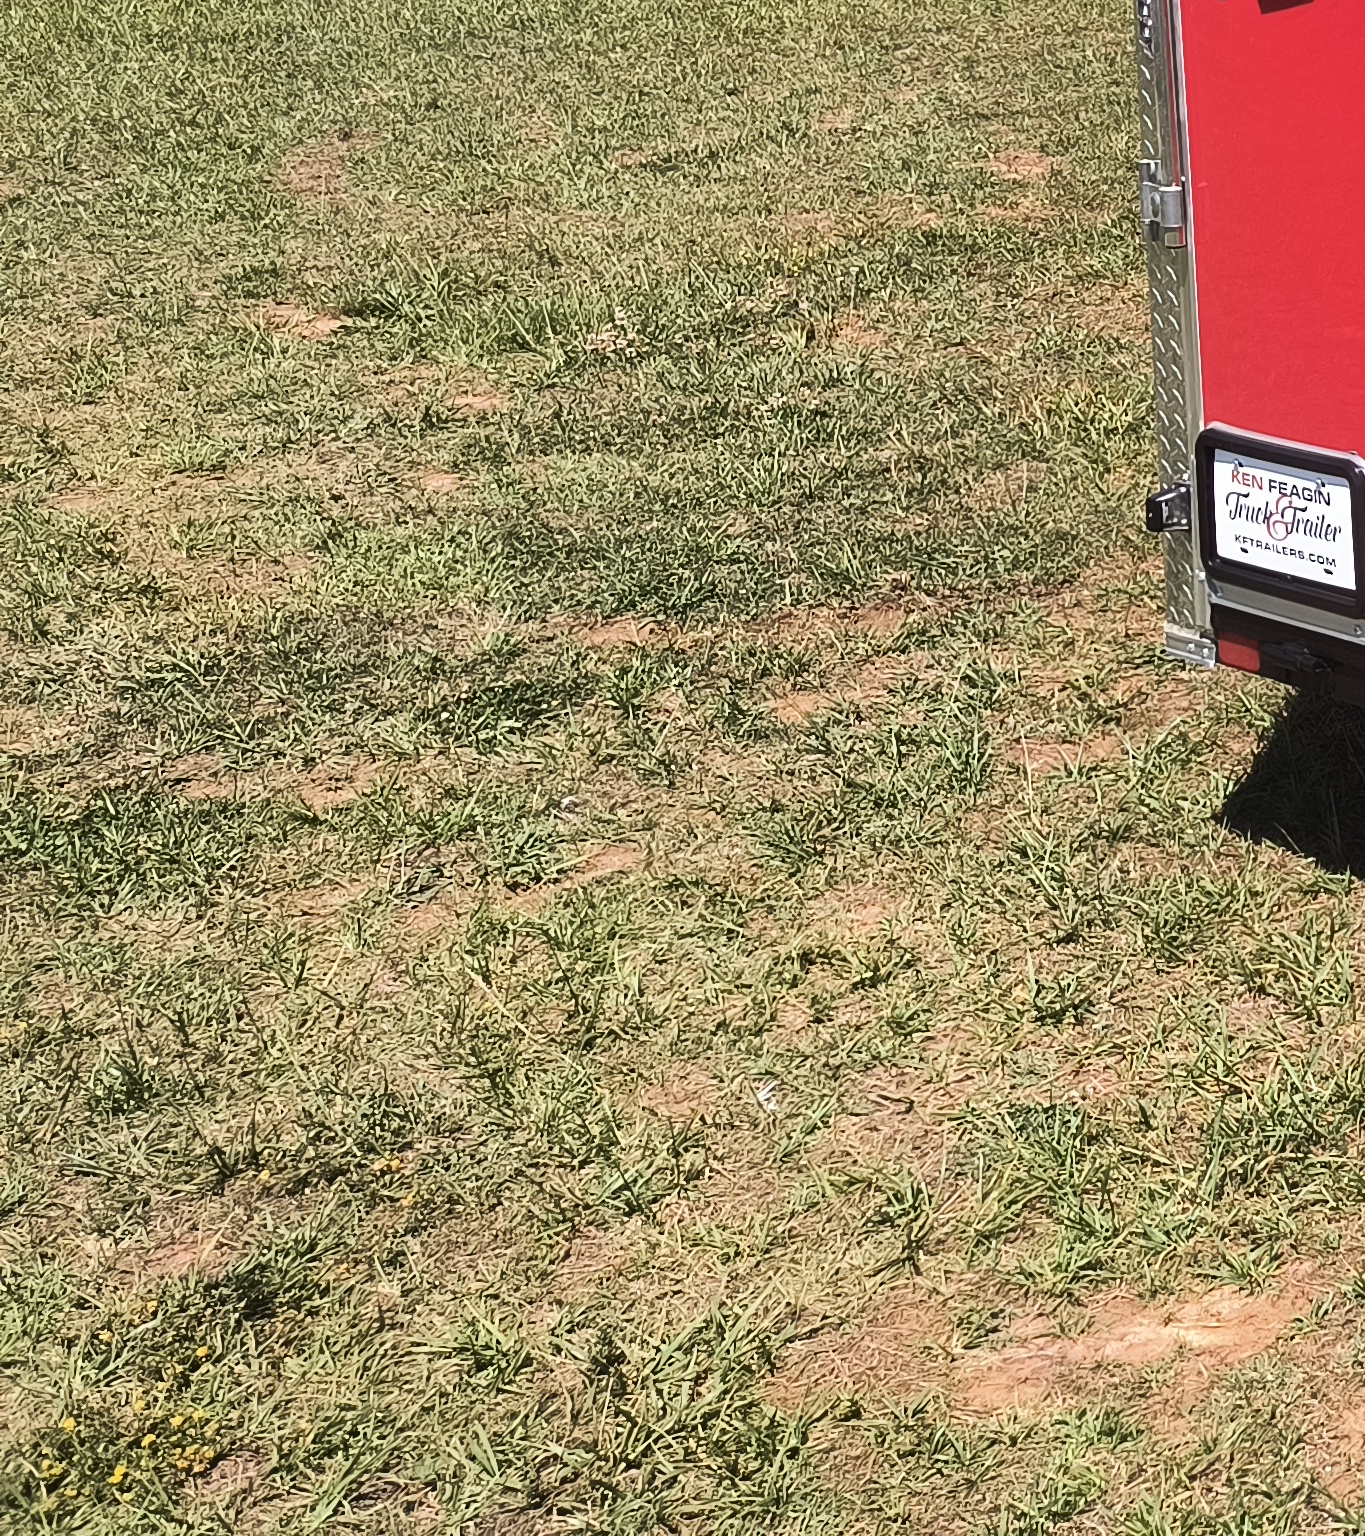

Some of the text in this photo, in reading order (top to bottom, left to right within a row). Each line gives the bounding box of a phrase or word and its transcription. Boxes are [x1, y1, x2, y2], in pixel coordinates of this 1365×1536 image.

[1231, 469, 1331, 506] KEN FEAGIN
[1226, 491, 1273, 525] Truck
[1281, 506, 1342, 542] Trailer
[1234, 534, 1337, 567] KFTRAILERS.COM
